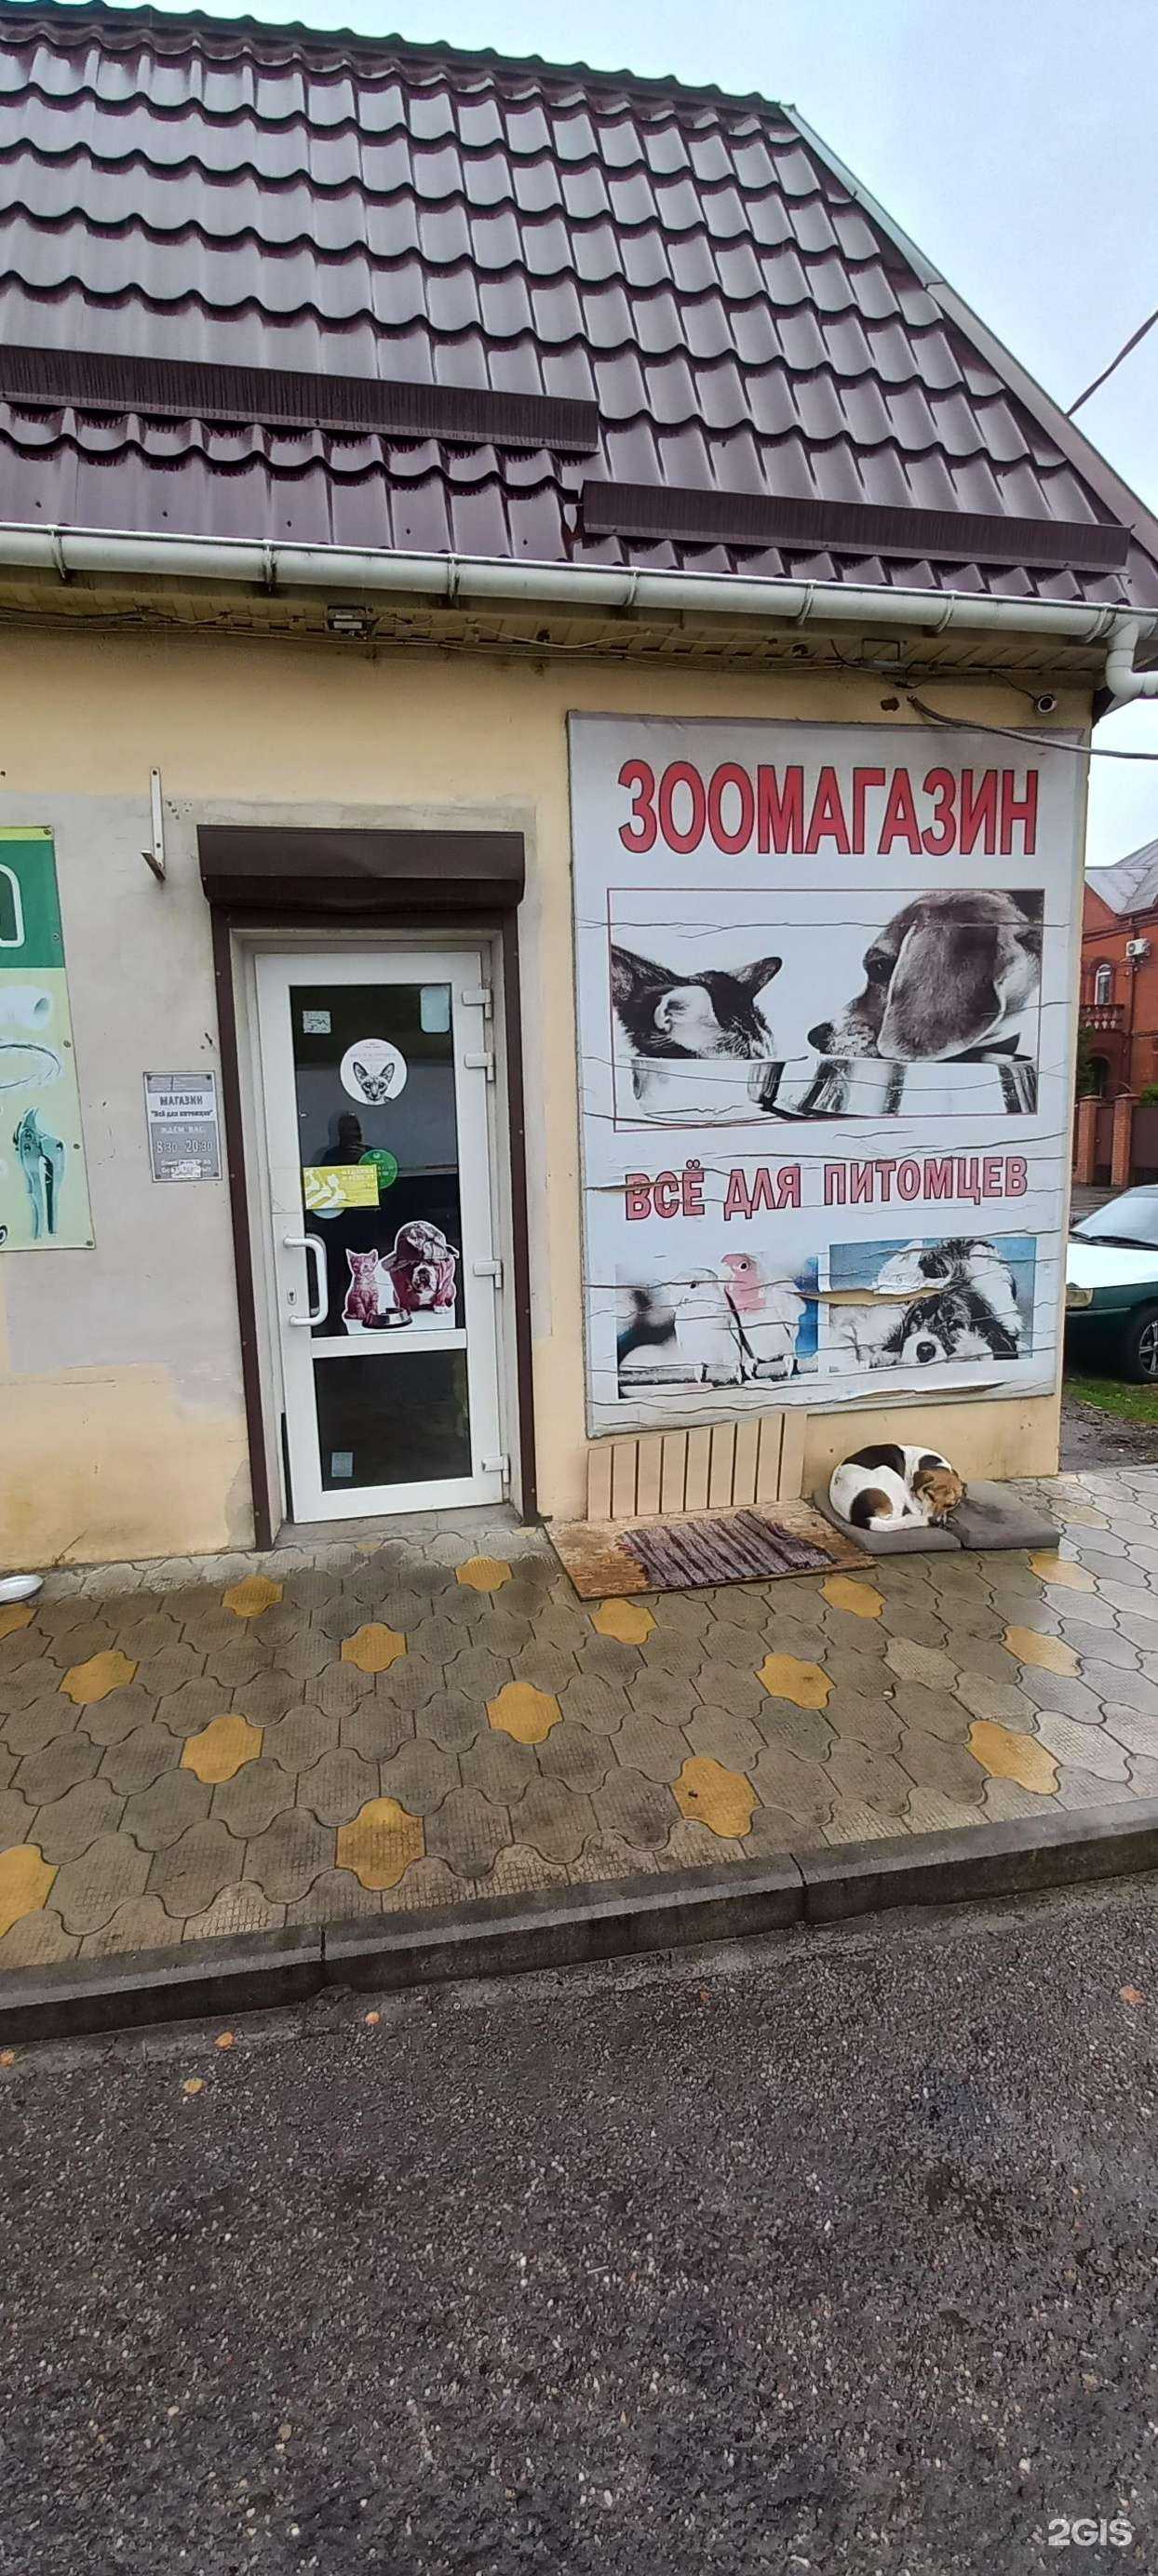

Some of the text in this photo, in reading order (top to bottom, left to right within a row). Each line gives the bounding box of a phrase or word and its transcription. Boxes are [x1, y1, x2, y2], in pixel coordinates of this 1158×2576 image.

[617, 758, 1039, 856] ЗООМАГАЗИН
[159, 1094, 203, 1106] МАГАЗИН
[625, 1155, 1029, 1221] ВСЁ ДЛЯ ПИТОМЦЕВ
